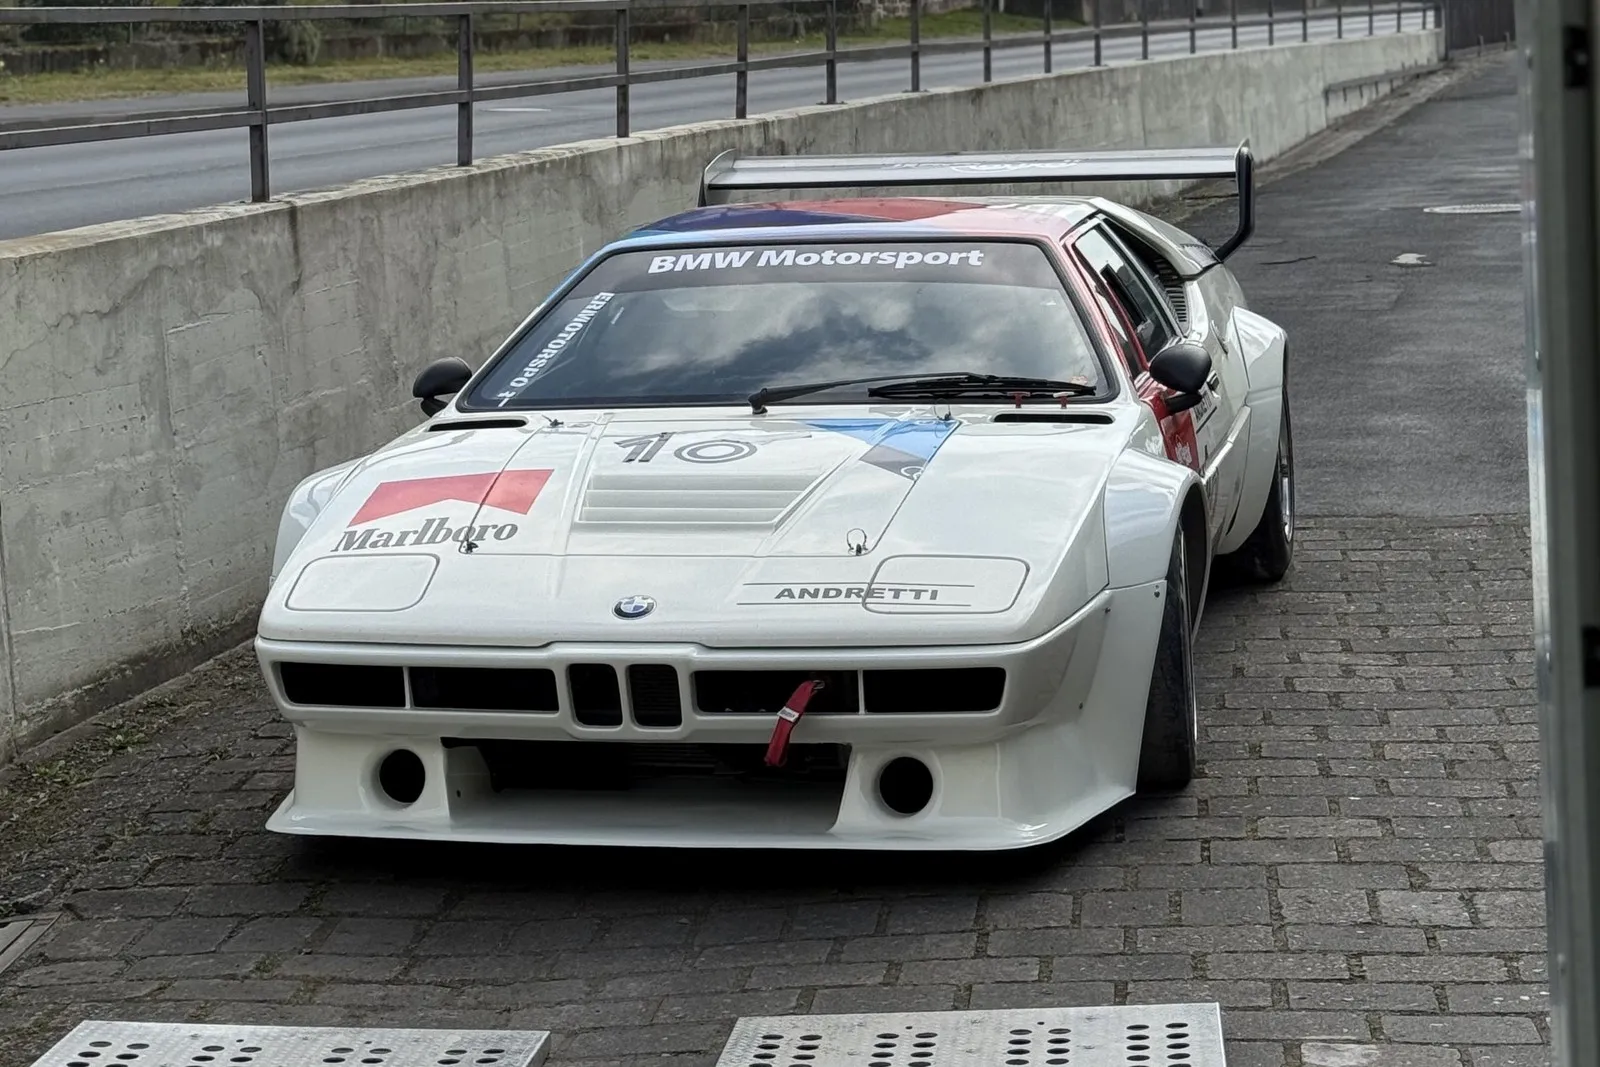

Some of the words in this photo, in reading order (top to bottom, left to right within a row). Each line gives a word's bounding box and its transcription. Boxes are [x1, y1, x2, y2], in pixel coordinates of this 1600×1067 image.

[648, 251, 754, 273] BMW
[757, 249, 984, 269] Motorsport
[614, 432, 757, 464] 10
[330, 517, 518, 552] Marlboro
[775, 588, 938, 600] ANDRETTI
